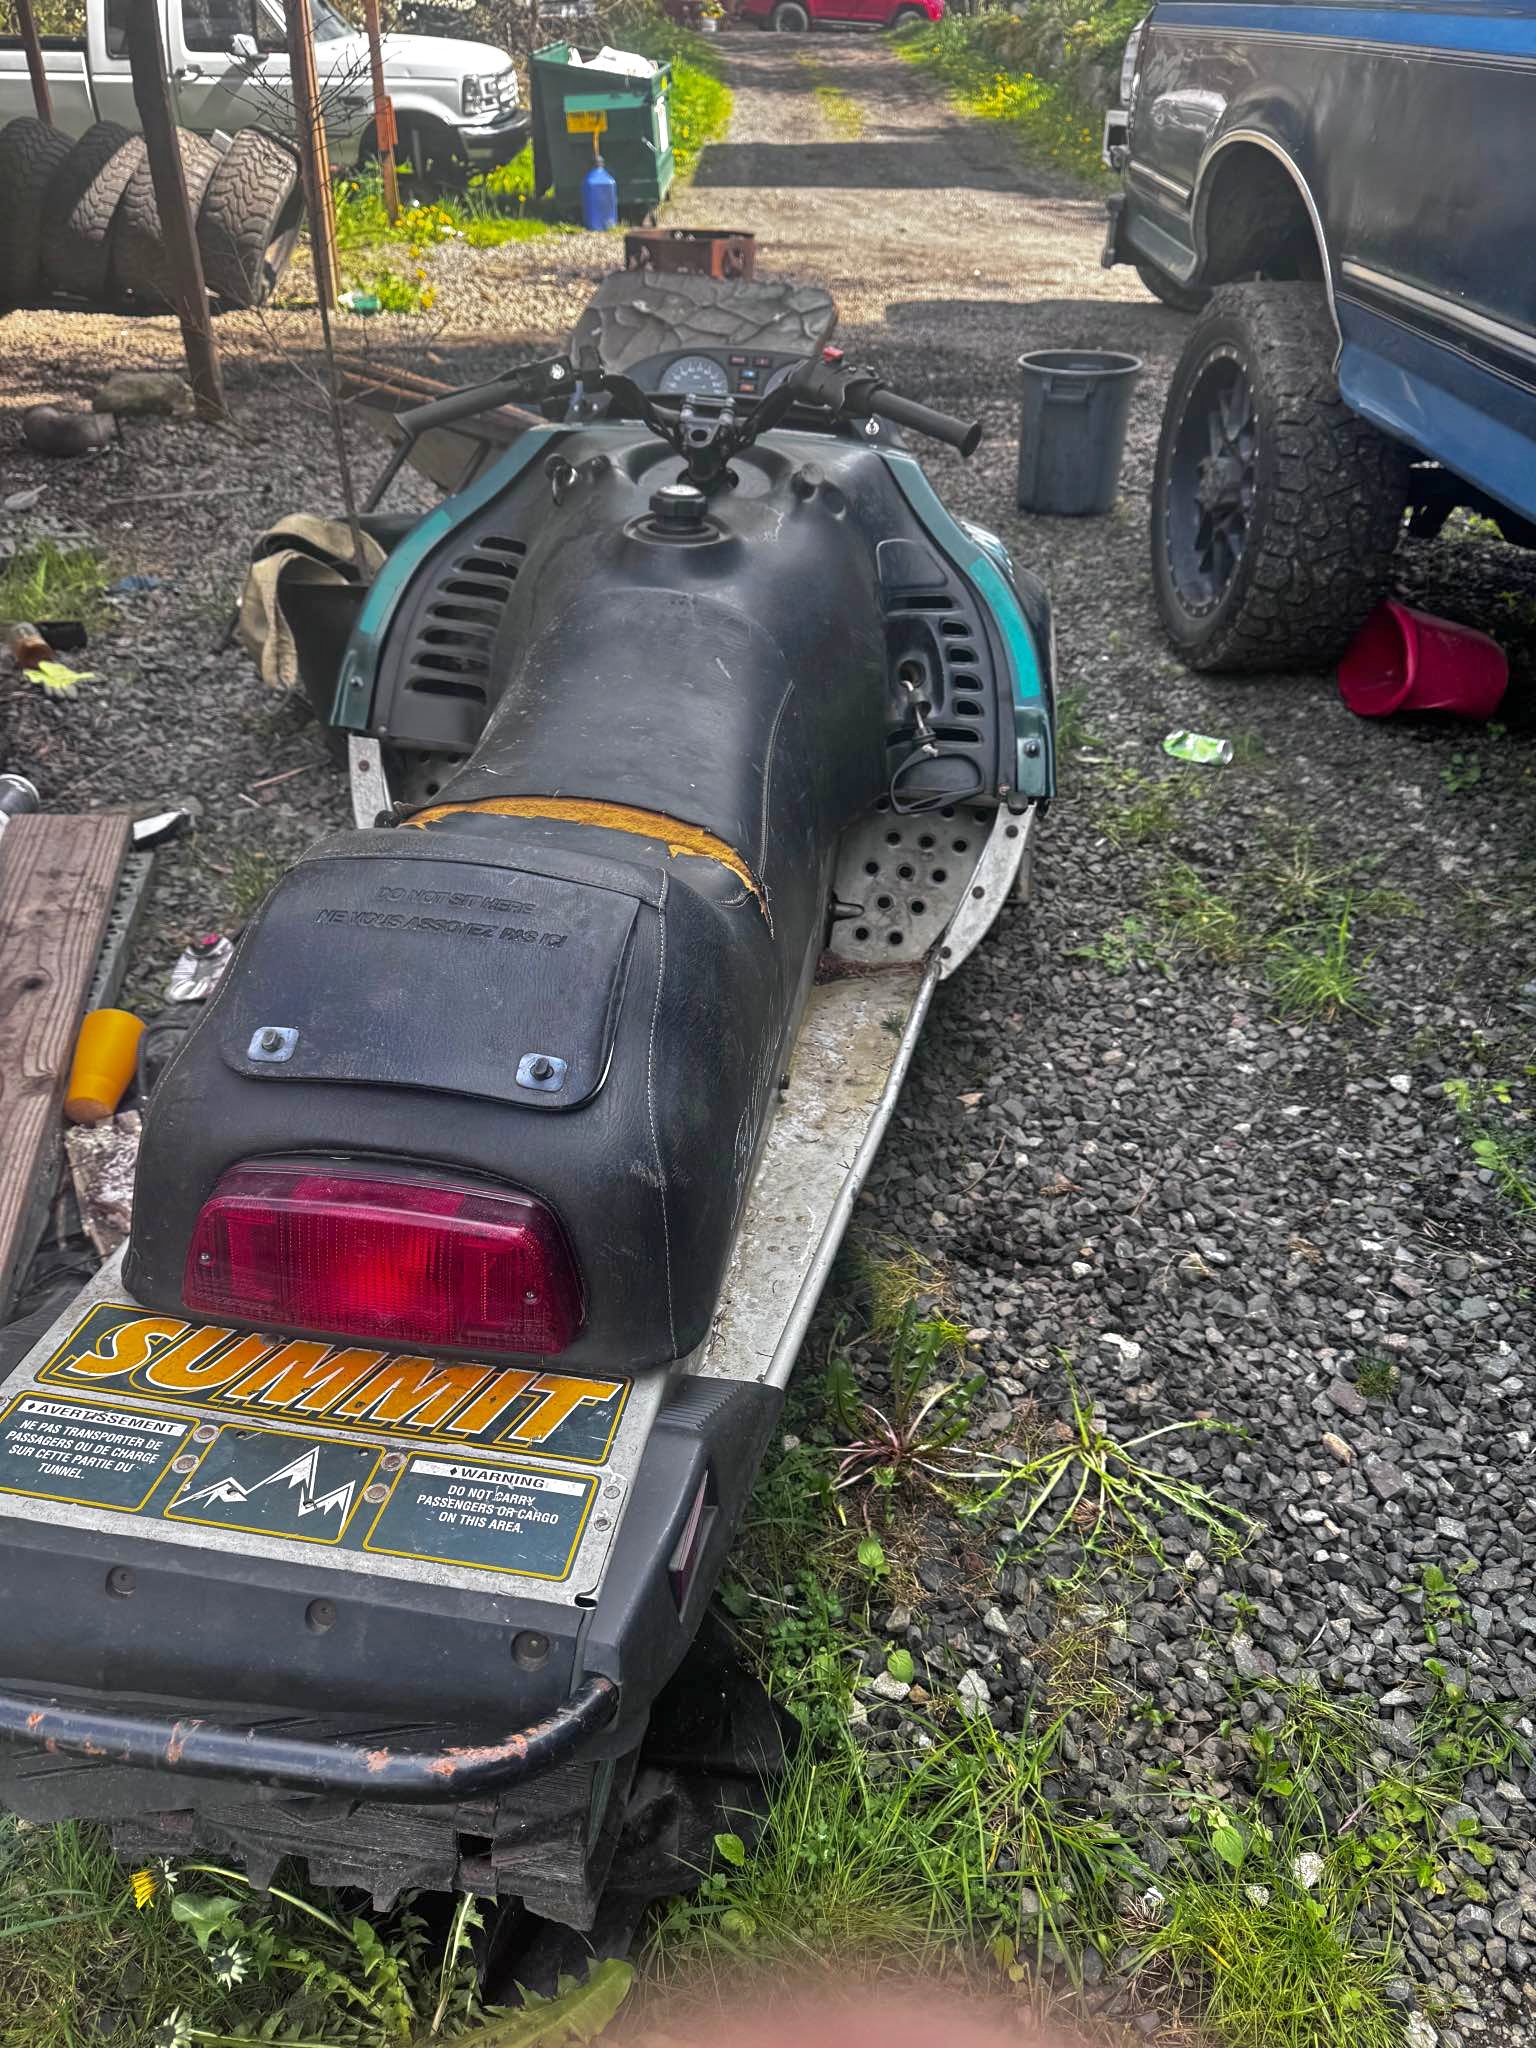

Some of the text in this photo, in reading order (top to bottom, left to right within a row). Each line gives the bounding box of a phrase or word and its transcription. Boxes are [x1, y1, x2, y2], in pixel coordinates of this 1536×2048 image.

[376, 886, 406, 901] DO
[408, 888, 450, 904] NOT
[481, 895, 537, 914] HERE
[315, 908, 348, 924] NE
[351, 910, 403, 930] VOUS
[404, 914, 499, 938] ASSOYEZ
[499, 926, 539, 944] PAS
[58, 1316, 621, 1446] SUMMIT
[37, 1403, 180, 1434] AVERTISSEMENT
[5, 1430, 160, 1465] PASSAGERS OU DE CHARGE
[20, 1419, 164, 1451] NE PAS TRANSPORTER DE
[8, 1444, 135, 1474] SUR CETTE PARTIE DU
[37, 1462, 85, 1480] TUNNEL.
[461, 1467, 545, 1489] WARNING
[416, 1494, 559, 1525] PASSENGERS OR CARGO
[448, 1485, 536, 1506] DO NOT CARRY
[438, 1510, 524, 1534] ON THIS AREA.
